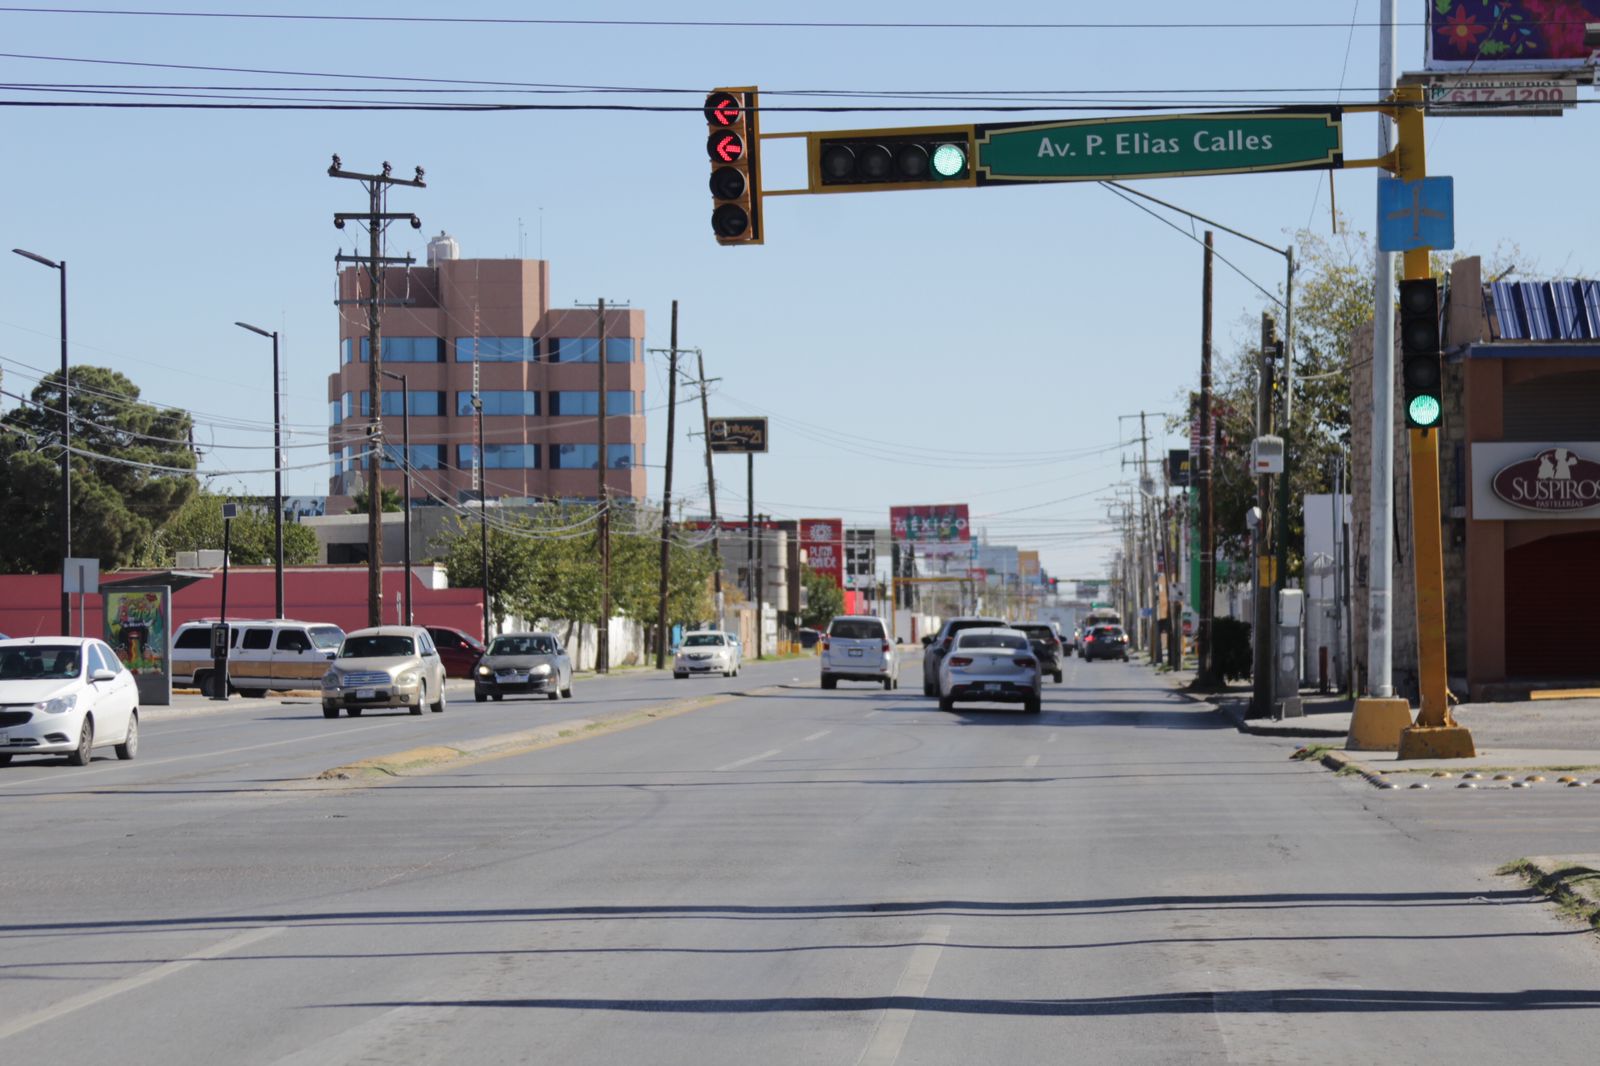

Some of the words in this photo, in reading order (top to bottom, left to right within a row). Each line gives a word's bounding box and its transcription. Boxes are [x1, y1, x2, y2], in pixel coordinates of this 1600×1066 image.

[1451, 87, 1564, 102] 617-1200
[1037, 137, 1077, 157] Av.
[1086, 134, 1106, 155] P.
[1193, 129, 1273, 152] Calles
